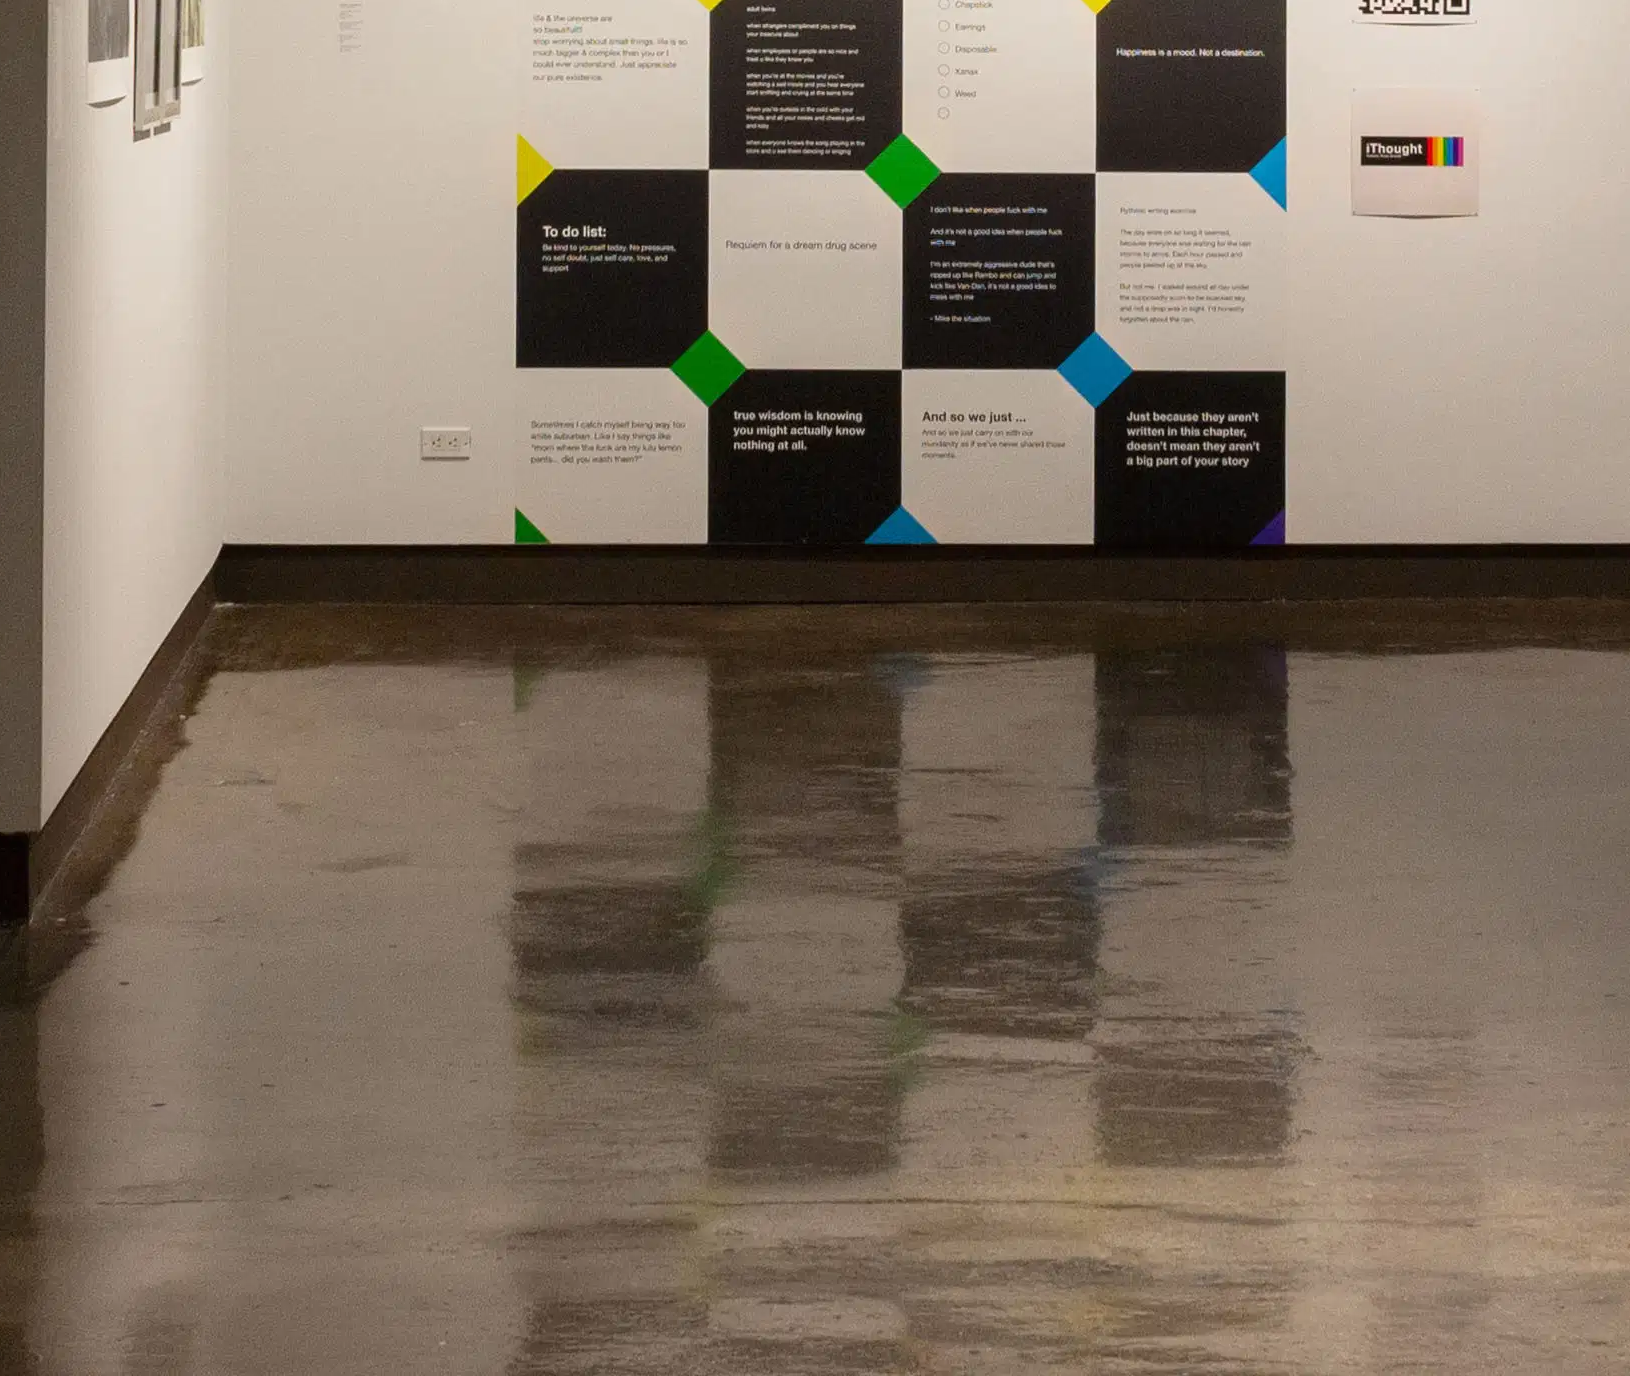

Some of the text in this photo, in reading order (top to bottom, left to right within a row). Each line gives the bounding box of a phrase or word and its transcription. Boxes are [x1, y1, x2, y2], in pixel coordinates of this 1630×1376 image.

[1366, 142, 1423, 156] iThought
[542, 225, 606, 238] To do list:
[725, 240, 767, 250] Requiem
[769, 240, 782, 249] for
[793, 241, 823, 250] dream
[825, 241, 847, 252] drug
[849, 242, 877, 250] scene
[733, 410, 863, 423] true wisdom is knowing
[922, 411, 947, 422] And
[950, 414, 965, 422] so
[968, 414, 986, 422] we
[989, 412, 1012, 424] just
[1126, 411, 1259, 424] Just because they aren't
[733, 425, 866, 437] you might actually know
[1126, 426, 1247, 438] written in this chapter,
[733, 440, 807, 452] nothing at all.
[1126, 441, 1260, 453] doesn't mean they aren't
[1126, 455, 1250, 468] a big part of your story
